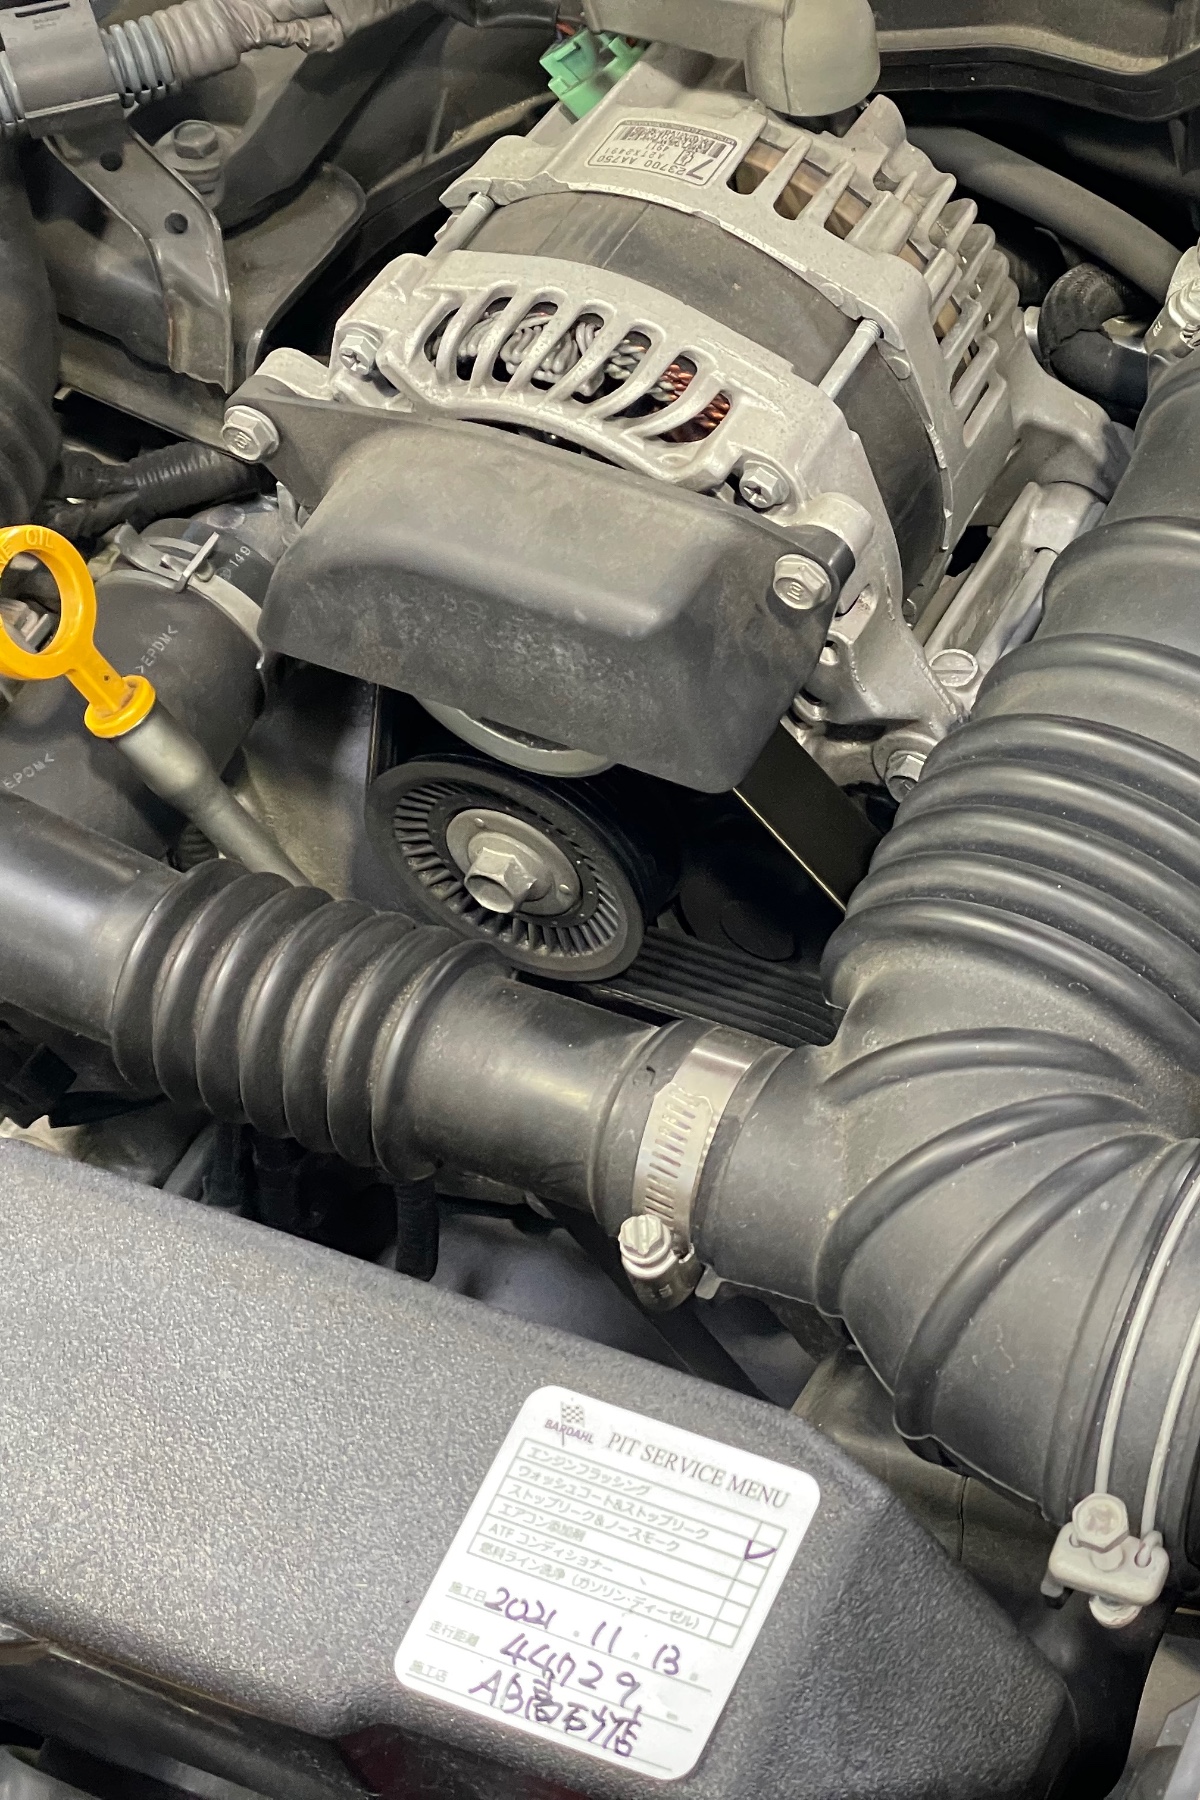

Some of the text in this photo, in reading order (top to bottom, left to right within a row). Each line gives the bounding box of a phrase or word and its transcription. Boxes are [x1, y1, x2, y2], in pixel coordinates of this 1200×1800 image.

[596, 155, 687, 176] 23700 AA750
[685, 159, 714, 181] 7
[25, 528, 54, 549] OIL
[544, 1419, 594, 1444] BARDAHL
[527, 1446, 651, 1496] エンジンフラッシング
[606, 1431, 791, 1509] PIT SERVICE MENU
[488, 1523, 515, 1538] ATF
[483, 1587, 681, 1676] 2021 11 13
